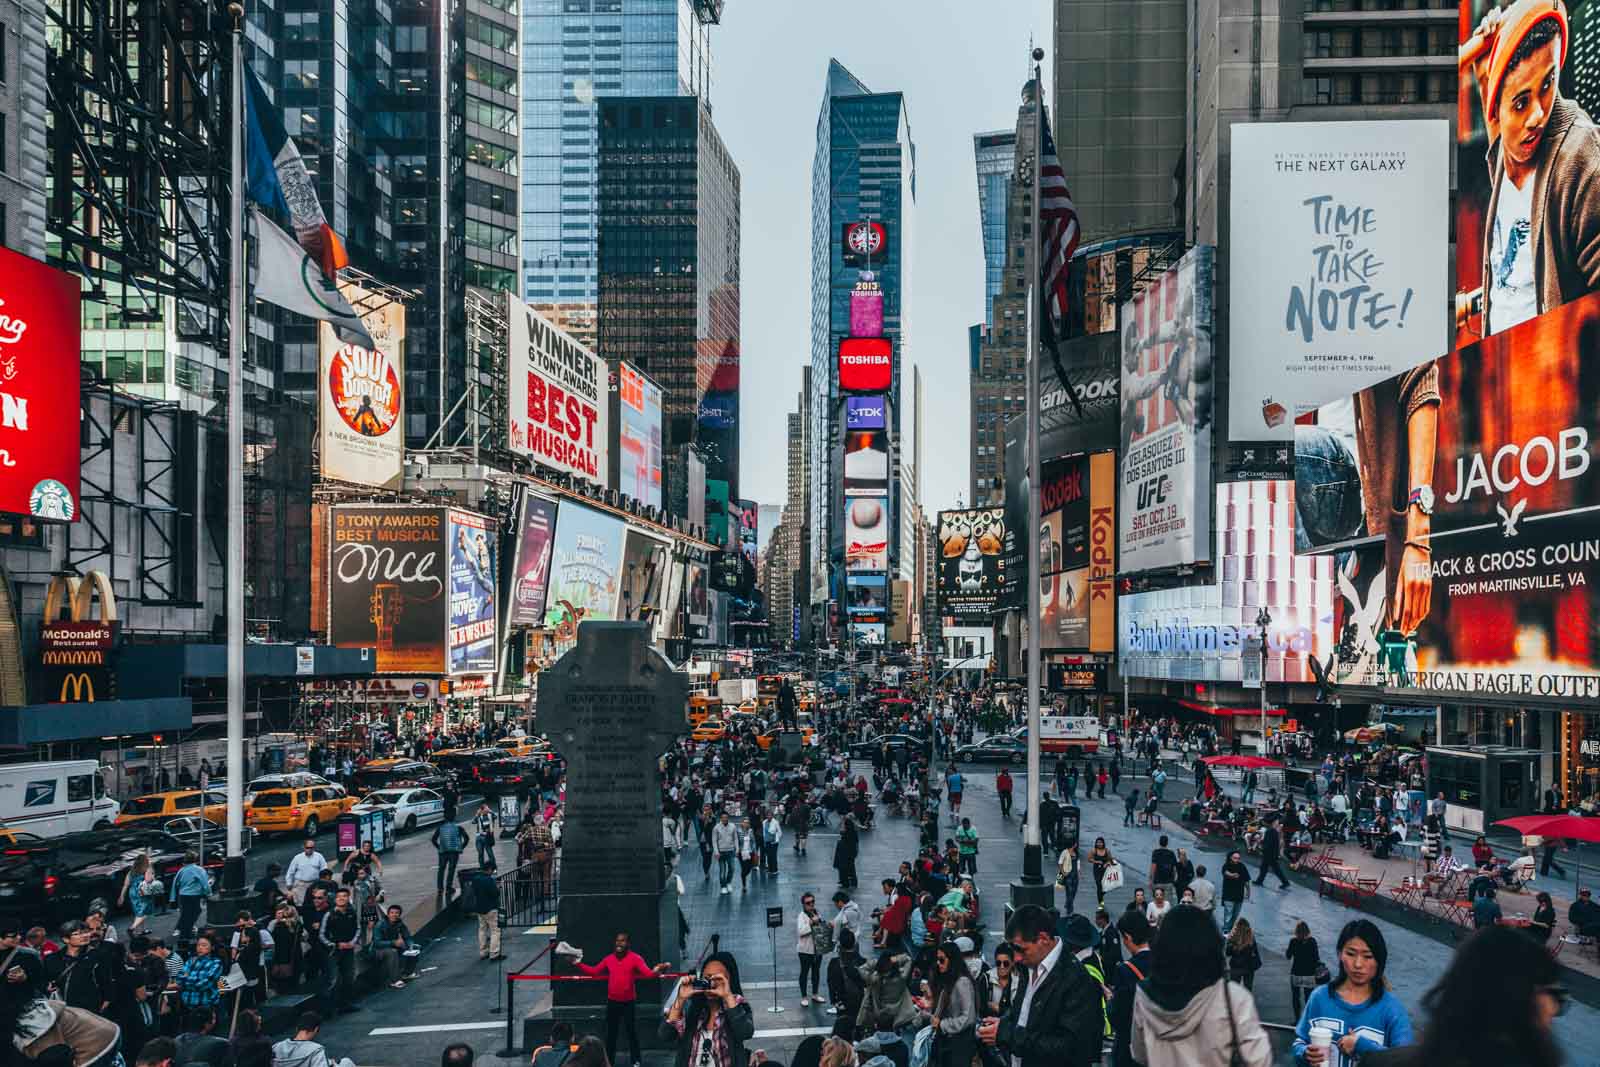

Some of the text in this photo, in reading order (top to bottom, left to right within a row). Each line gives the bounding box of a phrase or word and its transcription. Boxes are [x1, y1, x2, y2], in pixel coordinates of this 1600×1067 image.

[1275, 159, 1407, 172] THE NEXT GALAXY
[1303, 195, 1377, 235] TIME
[1312, 245, 1384, 284] TAKE
[856, 281, 878, 291] 2013
[1286, 276, 1413, 343] NOTE!
[338, 343, 390, 381] SOUL
[526, 312, 598, 384] WINNER!
[841, 355, 890, 365] TOSHIBA
[528, 345, 535, 362] 6
[537, 348, 562, 379] TONY
[563, 366, 598, 402] AWARDS
[1364, 364, 1392, 372] SQUARE
[527, 370, 598, 449] BEST
[858, 408, 882, 417] TDK
[527, 421, 598, 478] MUSICAL!
[1126, 447, 1185, 485] DOS SANTOS III
[1129, 434, 1173, 468] VELASQUEZ
[1173, 431, 1184, 449] VS
[1445, 426, 1591, 504] JACOB
[1137, 473, 1169, 511] UFC
[335, 529, 440, 542] BEST MUSICAL
[336, 515, 345, 528] 8
[348, 515, 381, 528] TONY
[383, 515, 440, 528] AWARDS
[1091, 507, 1112, 601] Kodak
[1464, 556, 1475, 574] &
[1480, 547, 1537, 573] CROSS
[1542, 539, 1600, 566] COUN
[1448, 571, 1587, 597] FROM MARTINSVILLE, VA
[42, 629, 110, 640] McDonald's
[1128, 620, 1161, 652] Bank
[1178, 624, 1313, 653] Amerca
[1387, 670, 1468, 692] AMERICAN
[1474, 673, 1532, 694] EAGLE
